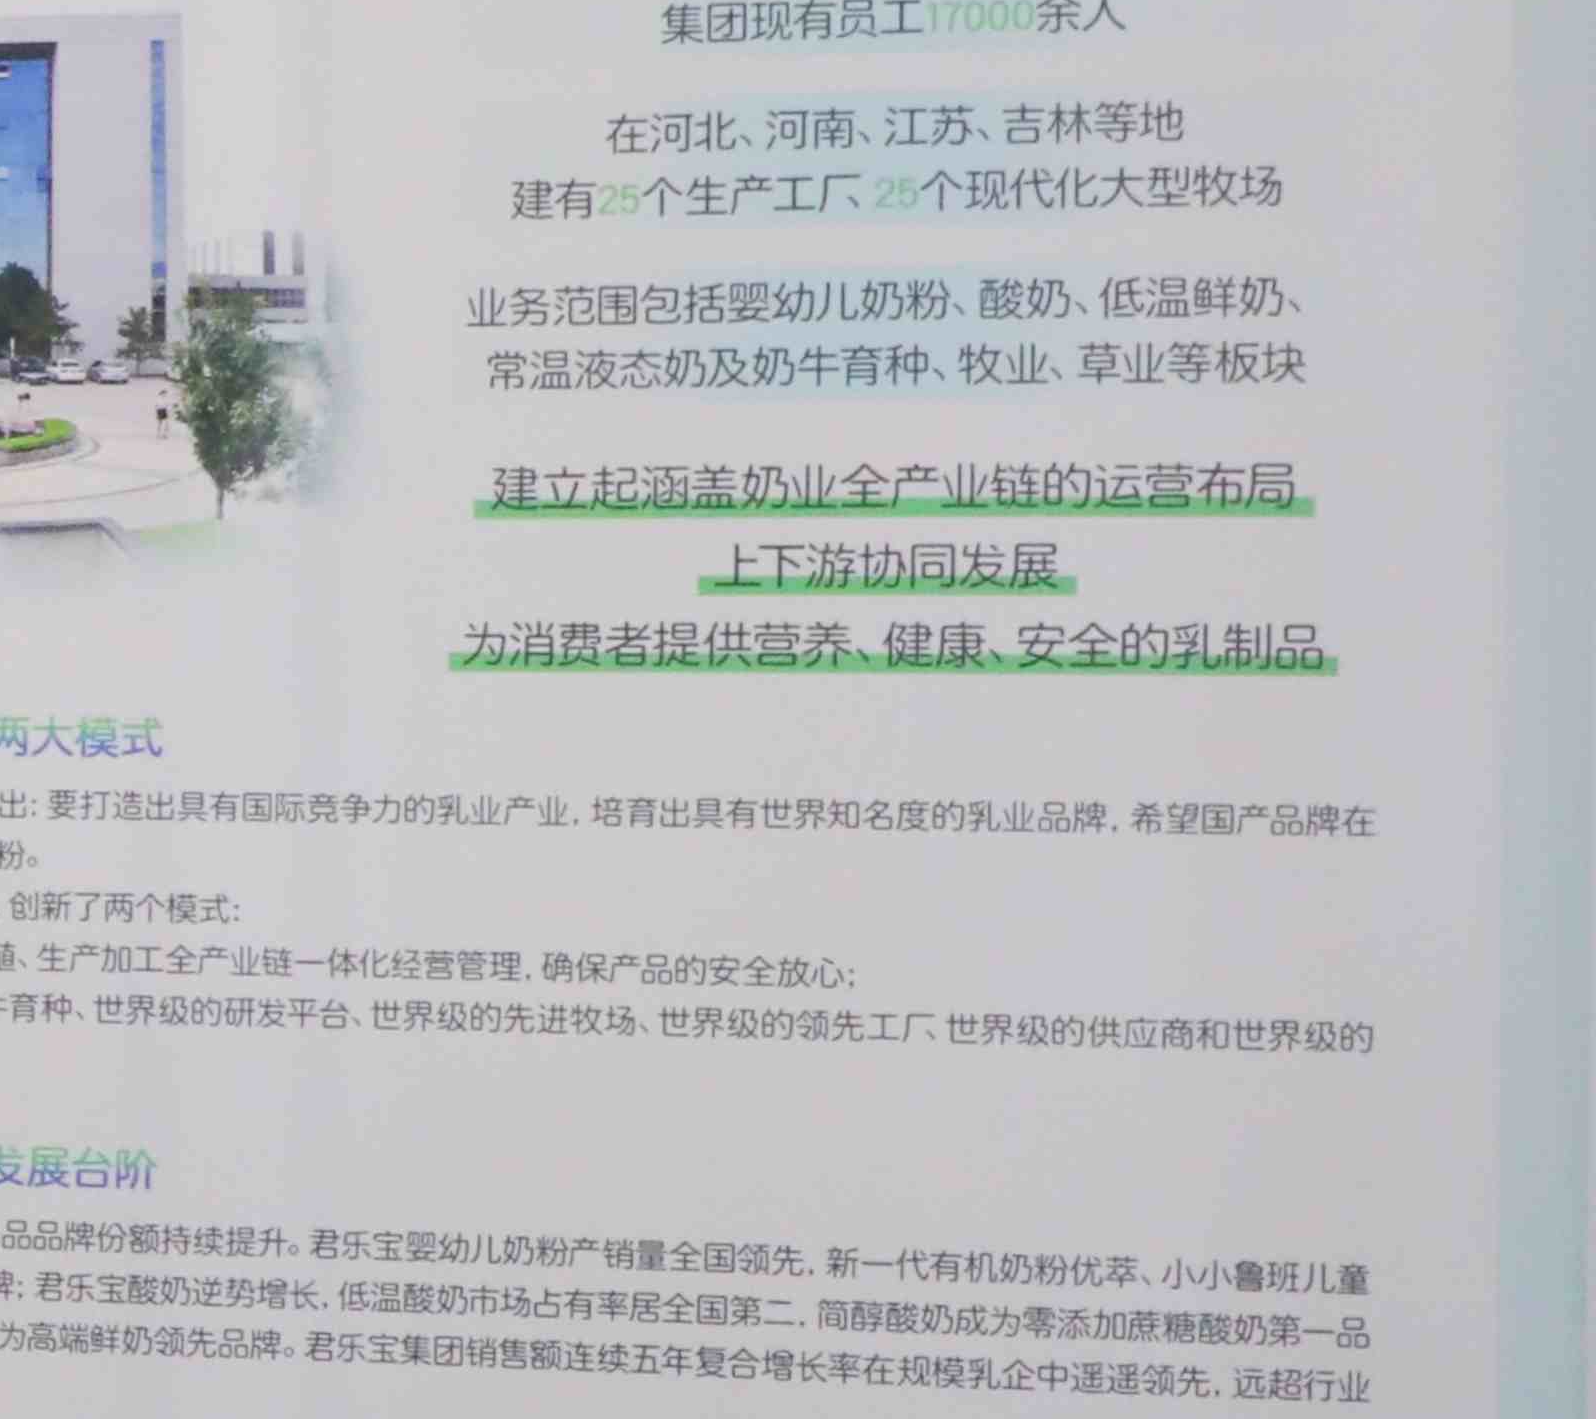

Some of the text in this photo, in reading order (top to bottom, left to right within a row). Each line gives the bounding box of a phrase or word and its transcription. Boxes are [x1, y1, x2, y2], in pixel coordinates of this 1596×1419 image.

[604, 99, 1186, 156] 在河北、河南、江苏、吉林等地
[510, 164, 1284, 223] 建有25个生产工厂、25个现代化大型牧场
[465, 275, 1304, 330] 业务范围包括婴幼儿奶粉、酸奶、低温鲜奶、
[486, 340, 1308, 392] 常温液态奶及奶牛育种、牧业、草业等板块
[490, 461, 1297, 513] 建立起涵盖奶业全产业链的运营布局
[714, 542, 1059, 591] 上下游协同发展
[461, 620, 1327, 672] 为消费者提供营养、健康、安全的乳制品
